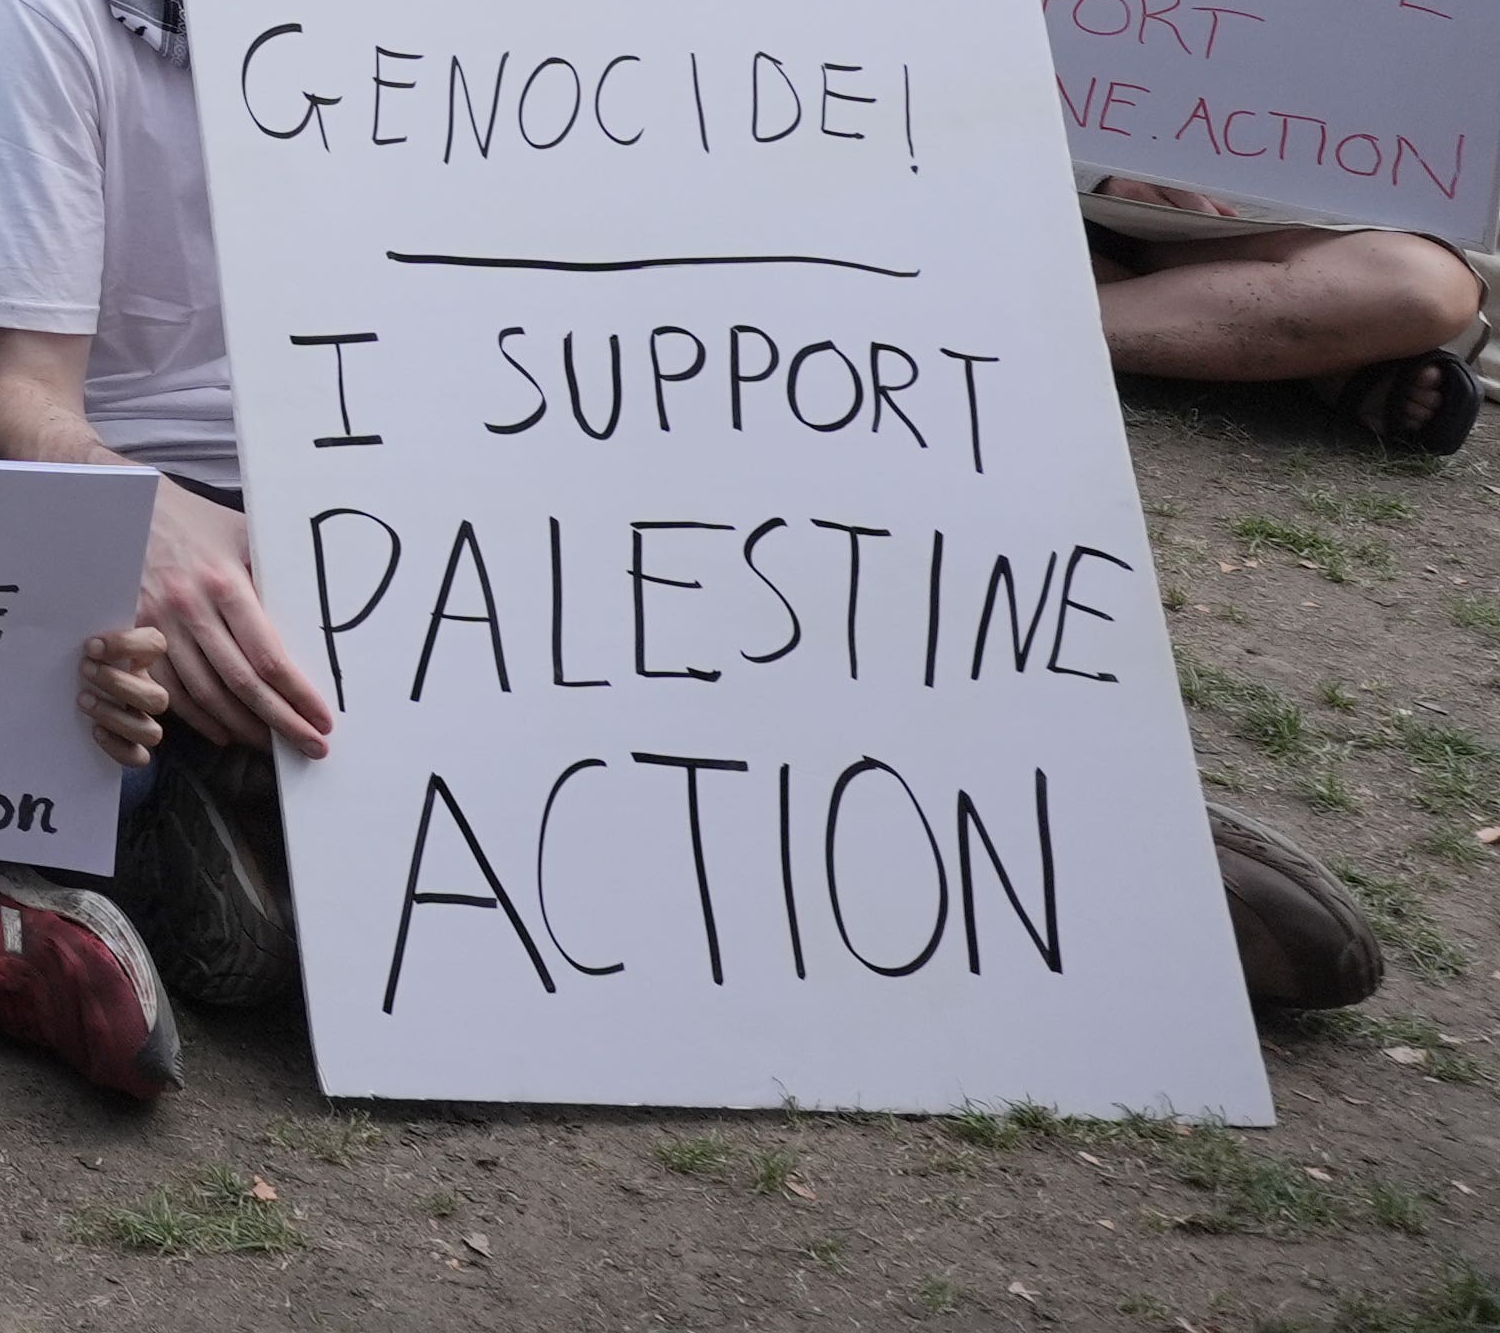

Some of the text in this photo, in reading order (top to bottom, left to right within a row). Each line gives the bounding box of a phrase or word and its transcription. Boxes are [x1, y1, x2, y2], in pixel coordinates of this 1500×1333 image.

[239, 22, 923, 176] GENOCIDE!
[289, 323, 1003, 475] I SUPPORT
[307, 507, 1135, 712] PALESTINE
[382, 752, 1065, 1015] ACTION
